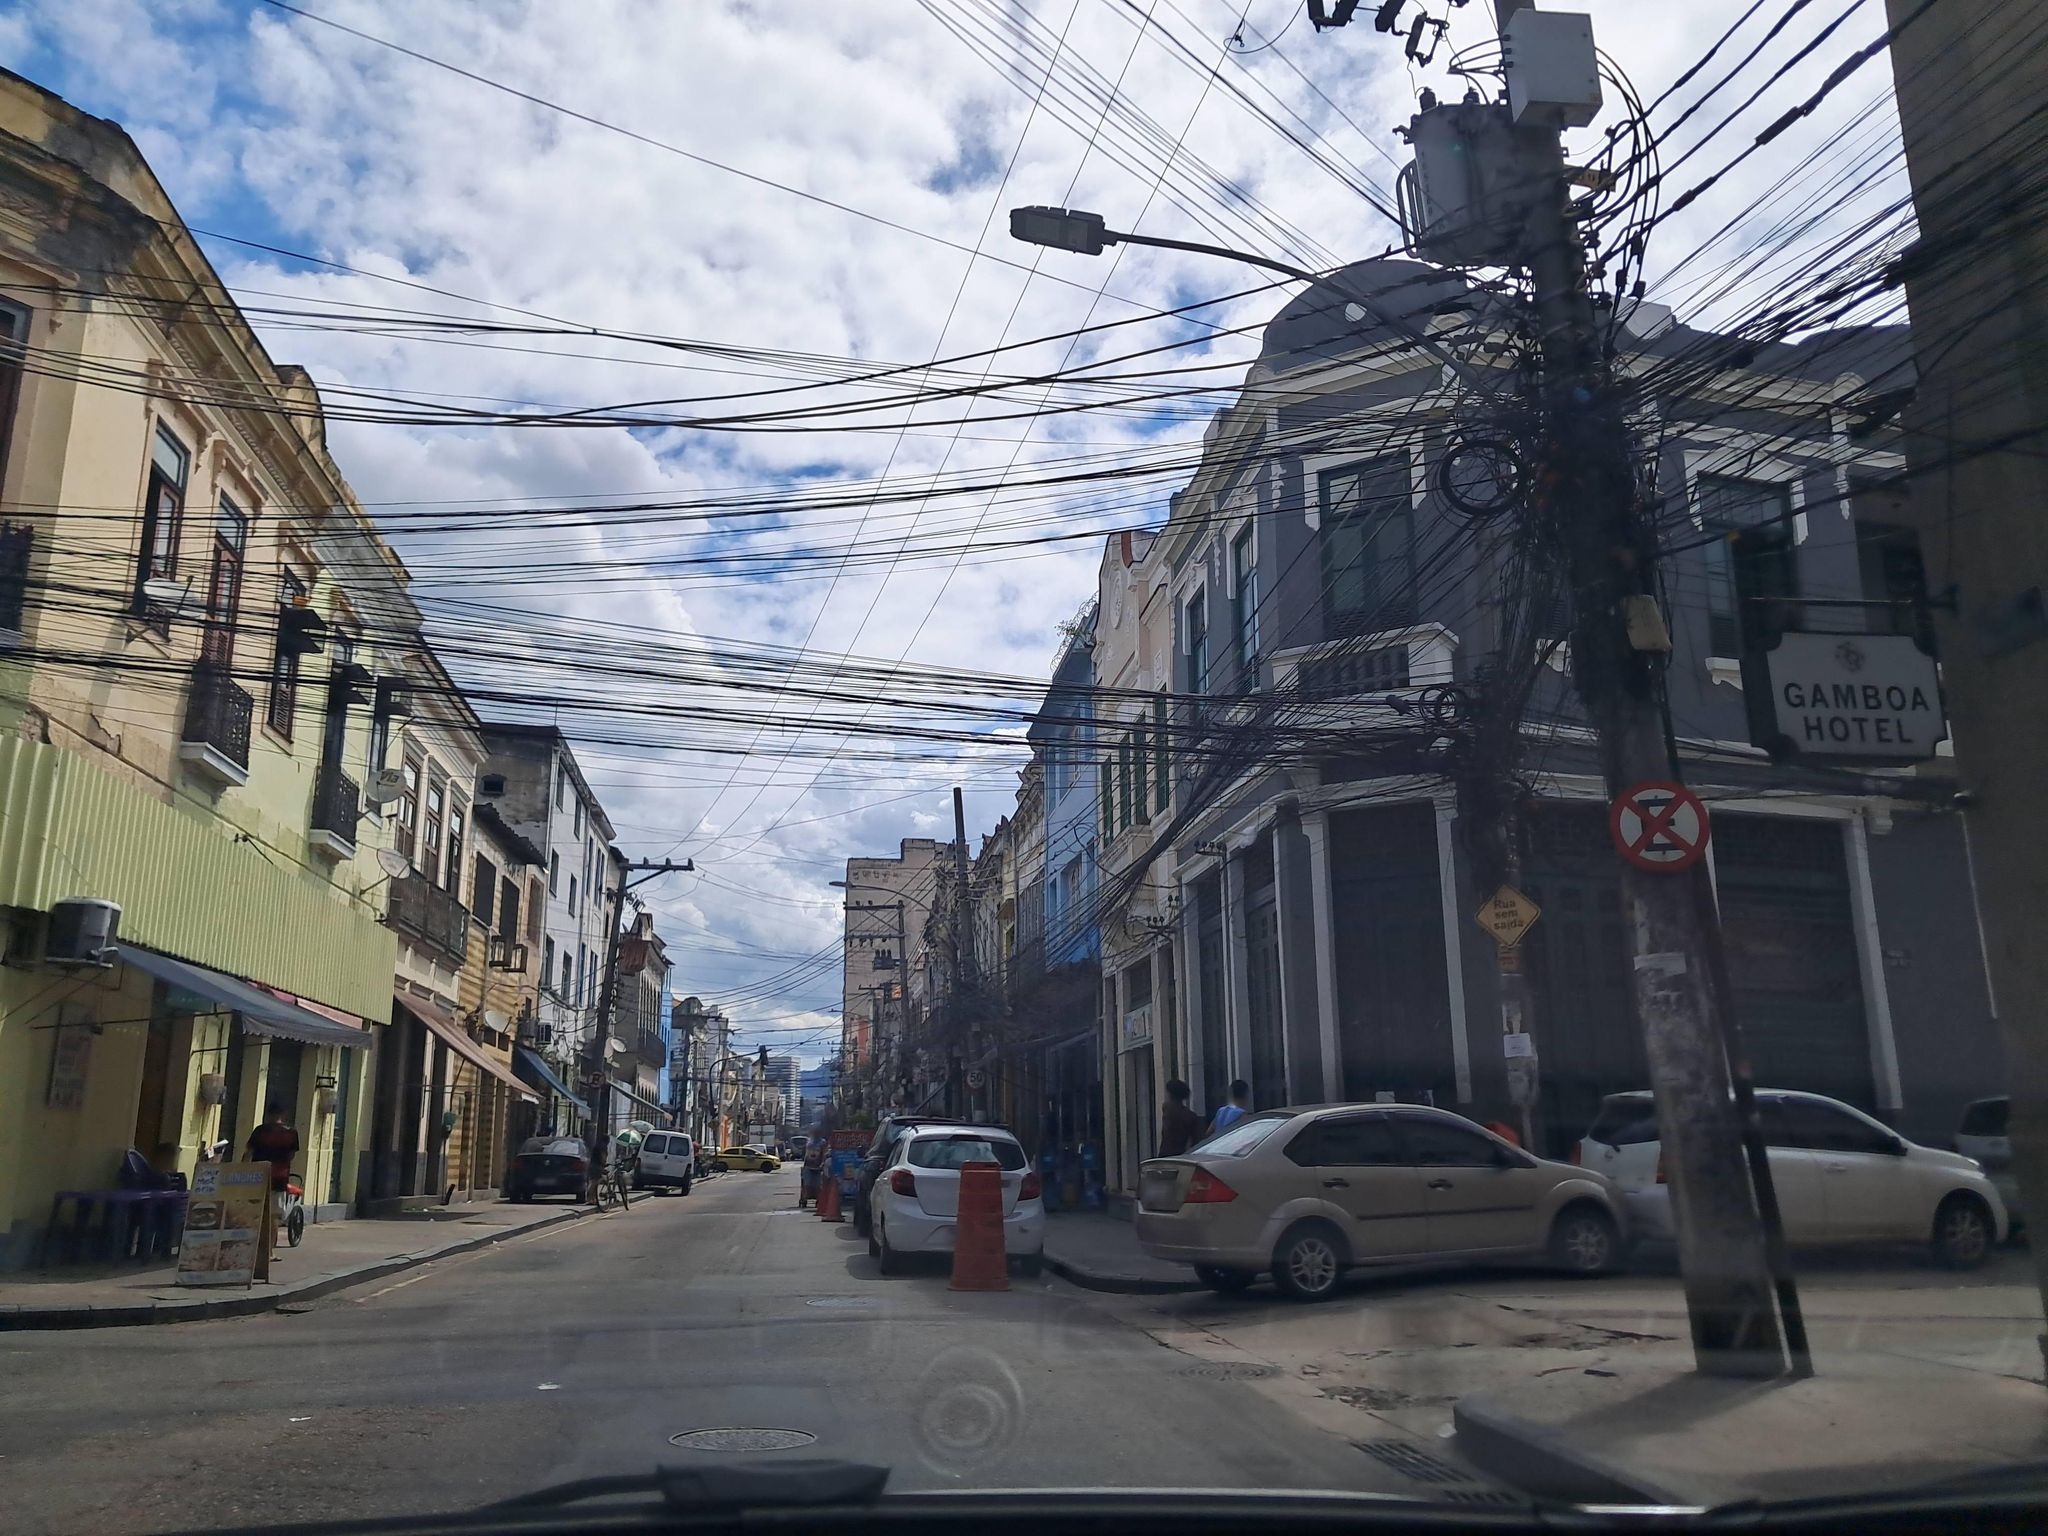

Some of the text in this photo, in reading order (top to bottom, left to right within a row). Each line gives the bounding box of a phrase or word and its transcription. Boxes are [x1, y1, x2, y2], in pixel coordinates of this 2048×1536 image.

[1784, 682, 1930, 711] GAMBOA
[1803, 716, 1914, 743] HOTEL
[1494, 900, 1516, 910] Rua
[1495, 910, 1518, 919] sem
[970, 1072, 983, 1083] 50
